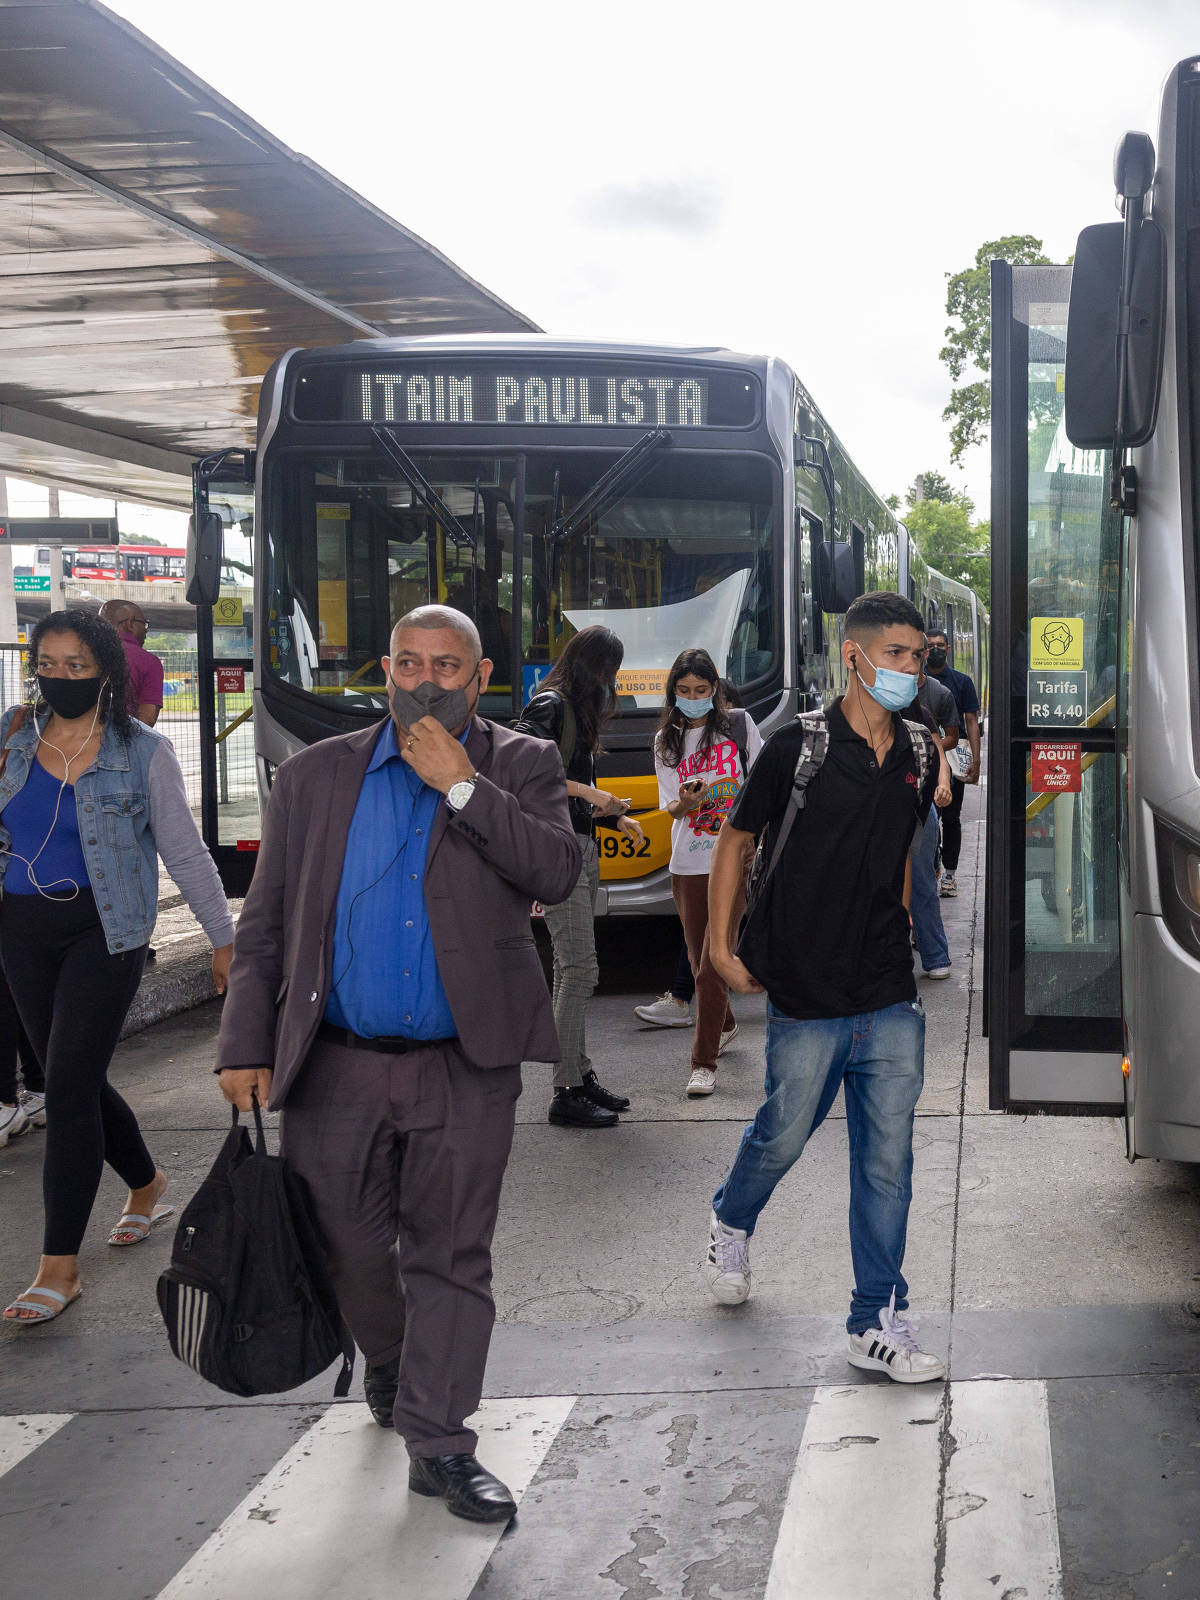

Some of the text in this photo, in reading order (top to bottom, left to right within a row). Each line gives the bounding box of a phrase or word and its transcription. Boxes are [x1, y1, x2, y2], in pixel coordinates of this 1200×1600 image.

[361, 374, 702, 425] ITAIM PAULISTA
[626, 683, 646, 691] USO
[1037, 681, 1078, 694] Tarifa
[1031, 704, 1083, 719] R$ 4,40
[1037, 750, 1075, 761] AQUI!
